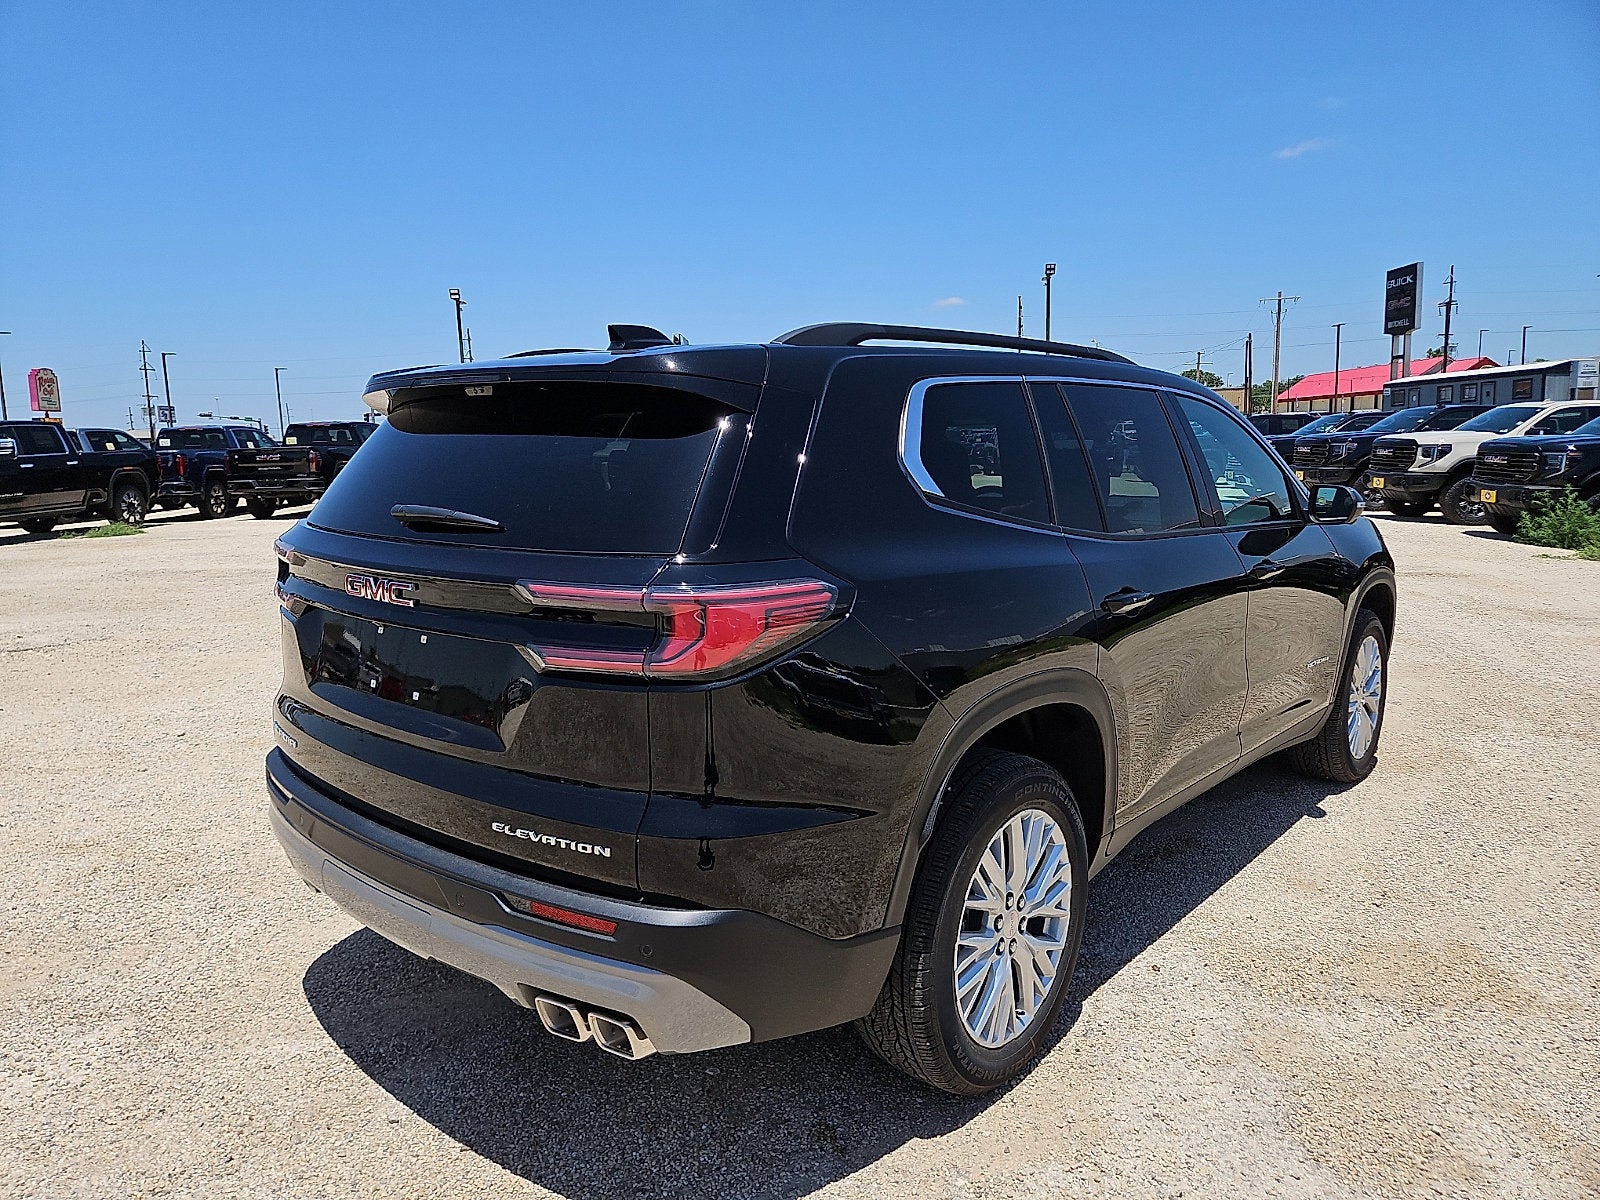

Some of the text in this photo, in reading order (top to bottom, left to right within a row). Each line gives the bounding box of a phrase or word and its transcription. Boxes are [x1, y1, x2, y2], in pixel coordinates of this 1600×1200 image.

[1387, 274, 1414, 289] BUICK
[344, 573, 415, 608] GMC
[491, 821, 612, 858] ELEVATION
